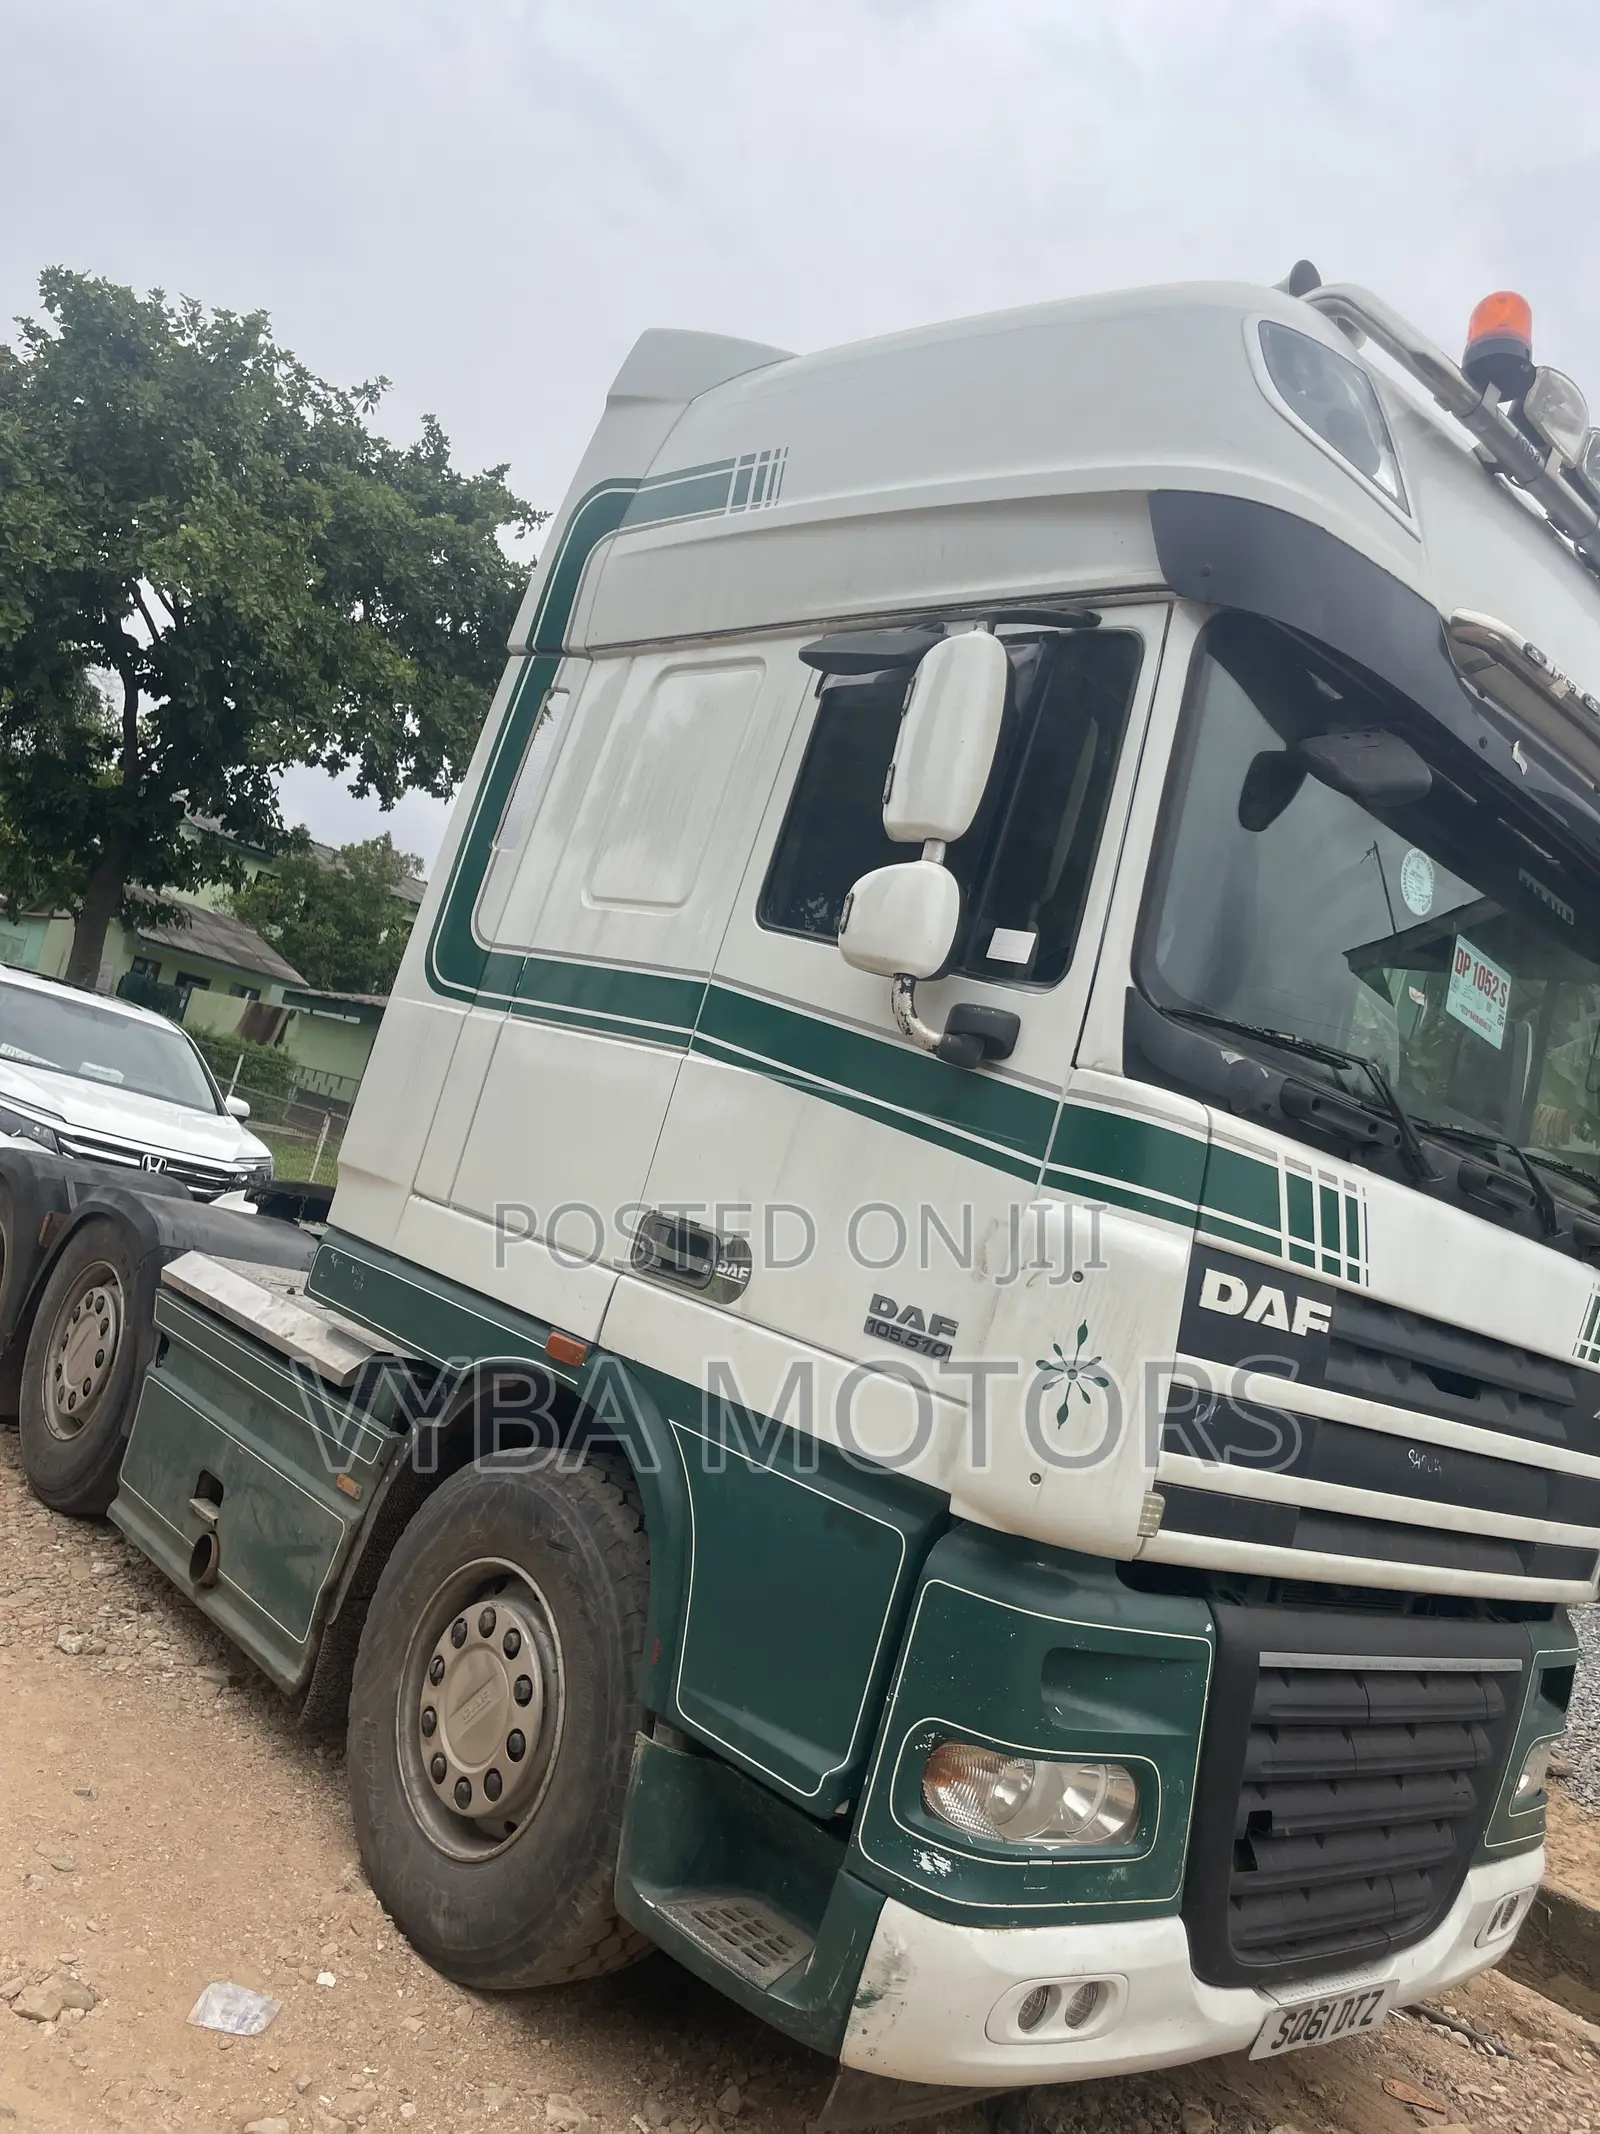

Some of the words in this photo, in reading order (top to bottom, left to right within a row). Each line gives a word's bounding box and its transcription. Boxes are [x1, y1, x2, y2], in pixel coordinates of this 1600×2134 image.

[1455, 946, 1471, 978] DP
[1473, 961, 1499, 1003] 1052
[1499, 982, 1507, 1008] S
[716, 1261, 750, 1281] DAF
[869, 1293, 959, 1338] DAF
[1199, 1269, 1332, 1336] DAF
[866, 1316, 950, 1359] 105.510
[1331, 1989, 1385, 2035] DTZ
